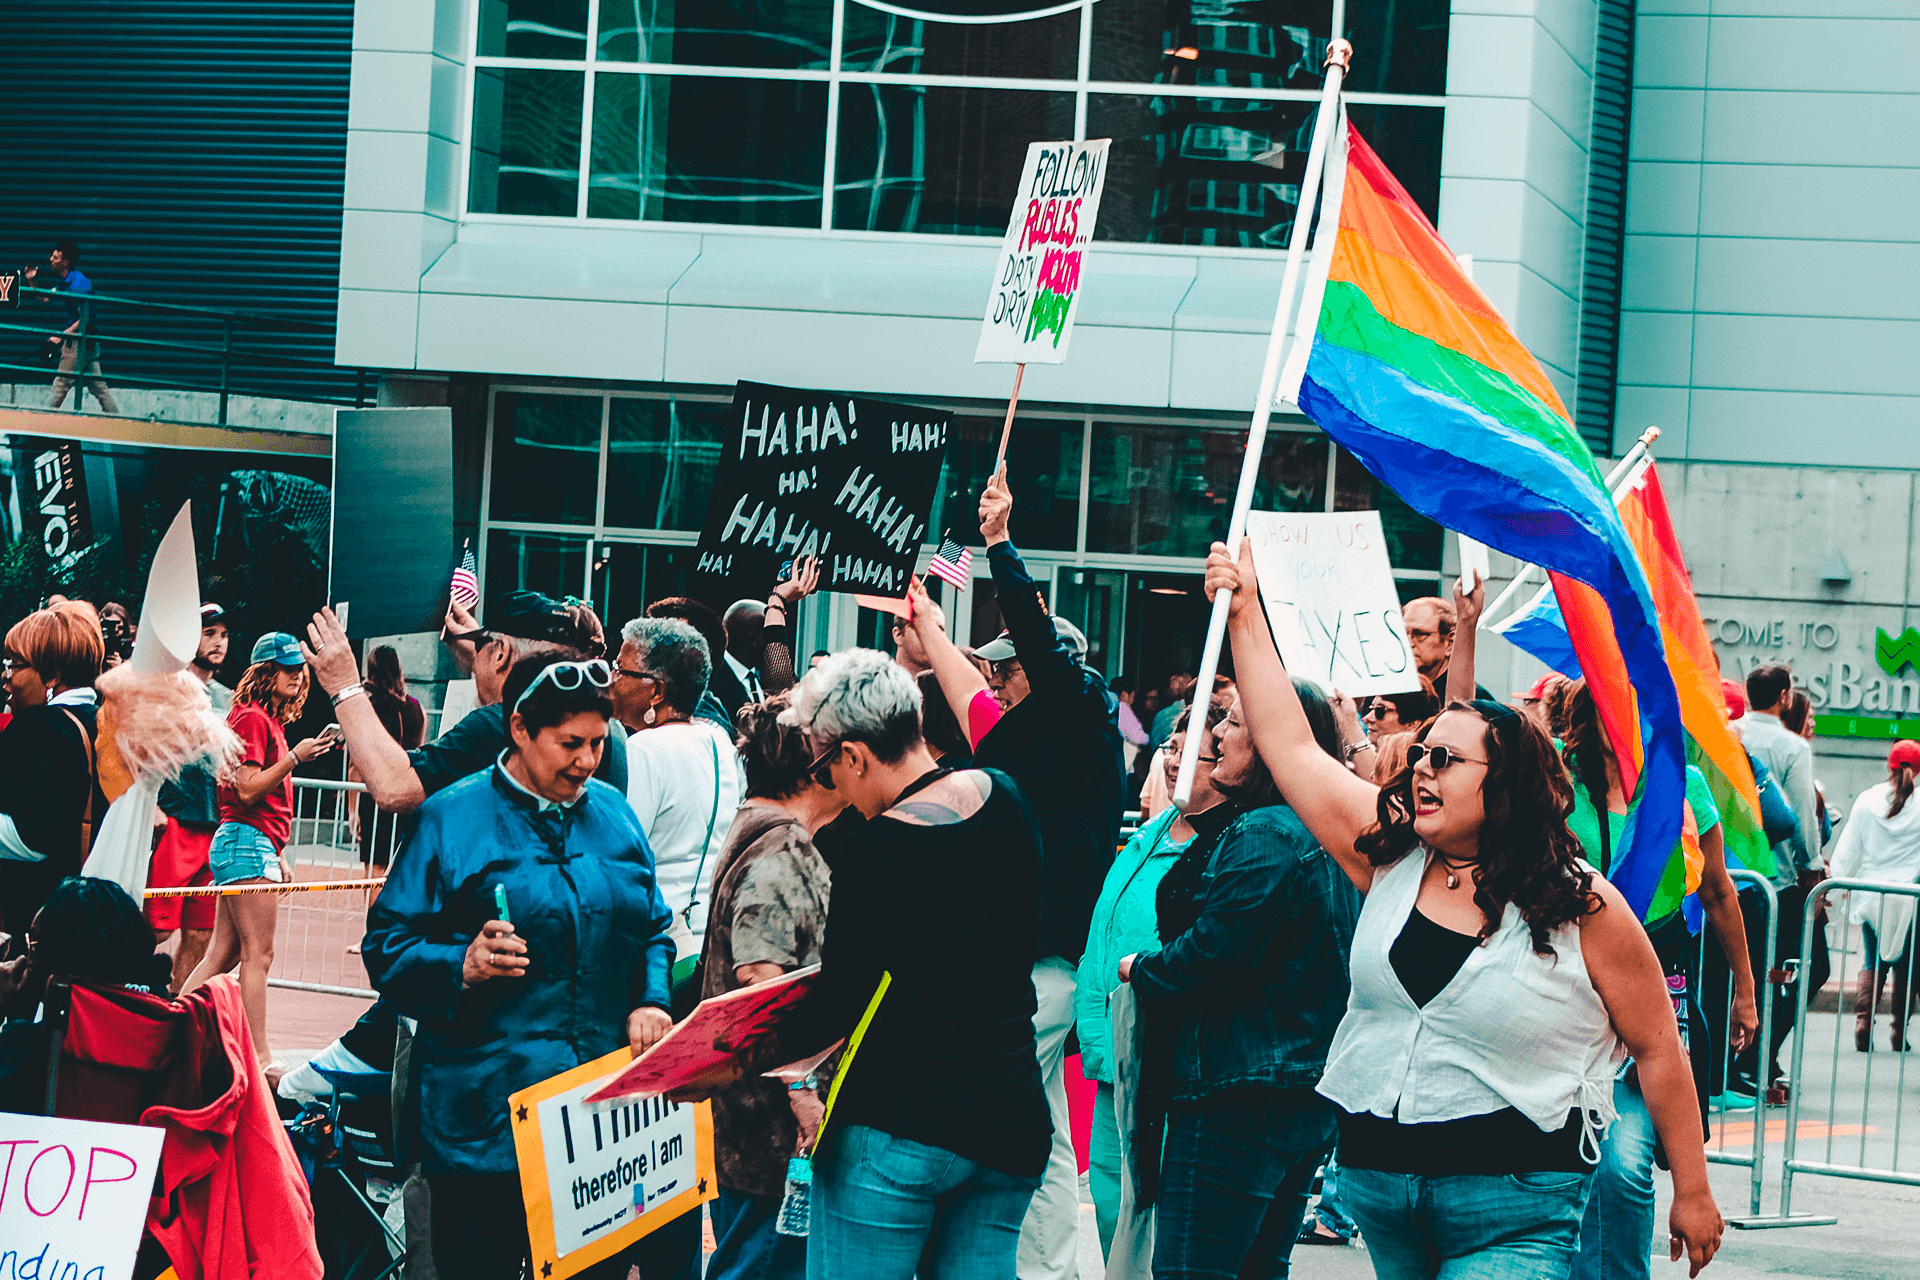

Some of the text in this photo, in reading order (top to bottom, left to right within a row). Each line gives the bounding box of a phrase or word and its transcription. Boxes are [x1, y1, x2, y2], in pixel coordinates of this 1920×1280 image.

[1030, 145, 1102, 198] FOLLOW
[1001, 253, 1038, 292] DIRTY
[993, 287, 1074, 351] DIRTY MONEY
[739, 400, 858, 461] HAHA!
[891, 421, 947, 453] HAH!
[778, 465, 817, 496] HA!
[721, 493, 831, 565] HAHA!
[834, 465, 925, 555] HAHA!
[1254, 515, 1370, 550] SHOW US
[697, 551, 732, 577] HA!
[832, 554, 904, 591] HAHA!
[1285, 554, 1342, 586] YOUR
[1799, 621, 1839, 651] TO
[561, 1104, 575, 1164] I
[0, 1140, 138, 1220] TOP
[572, 1133, 683, 1210] therefore I am
